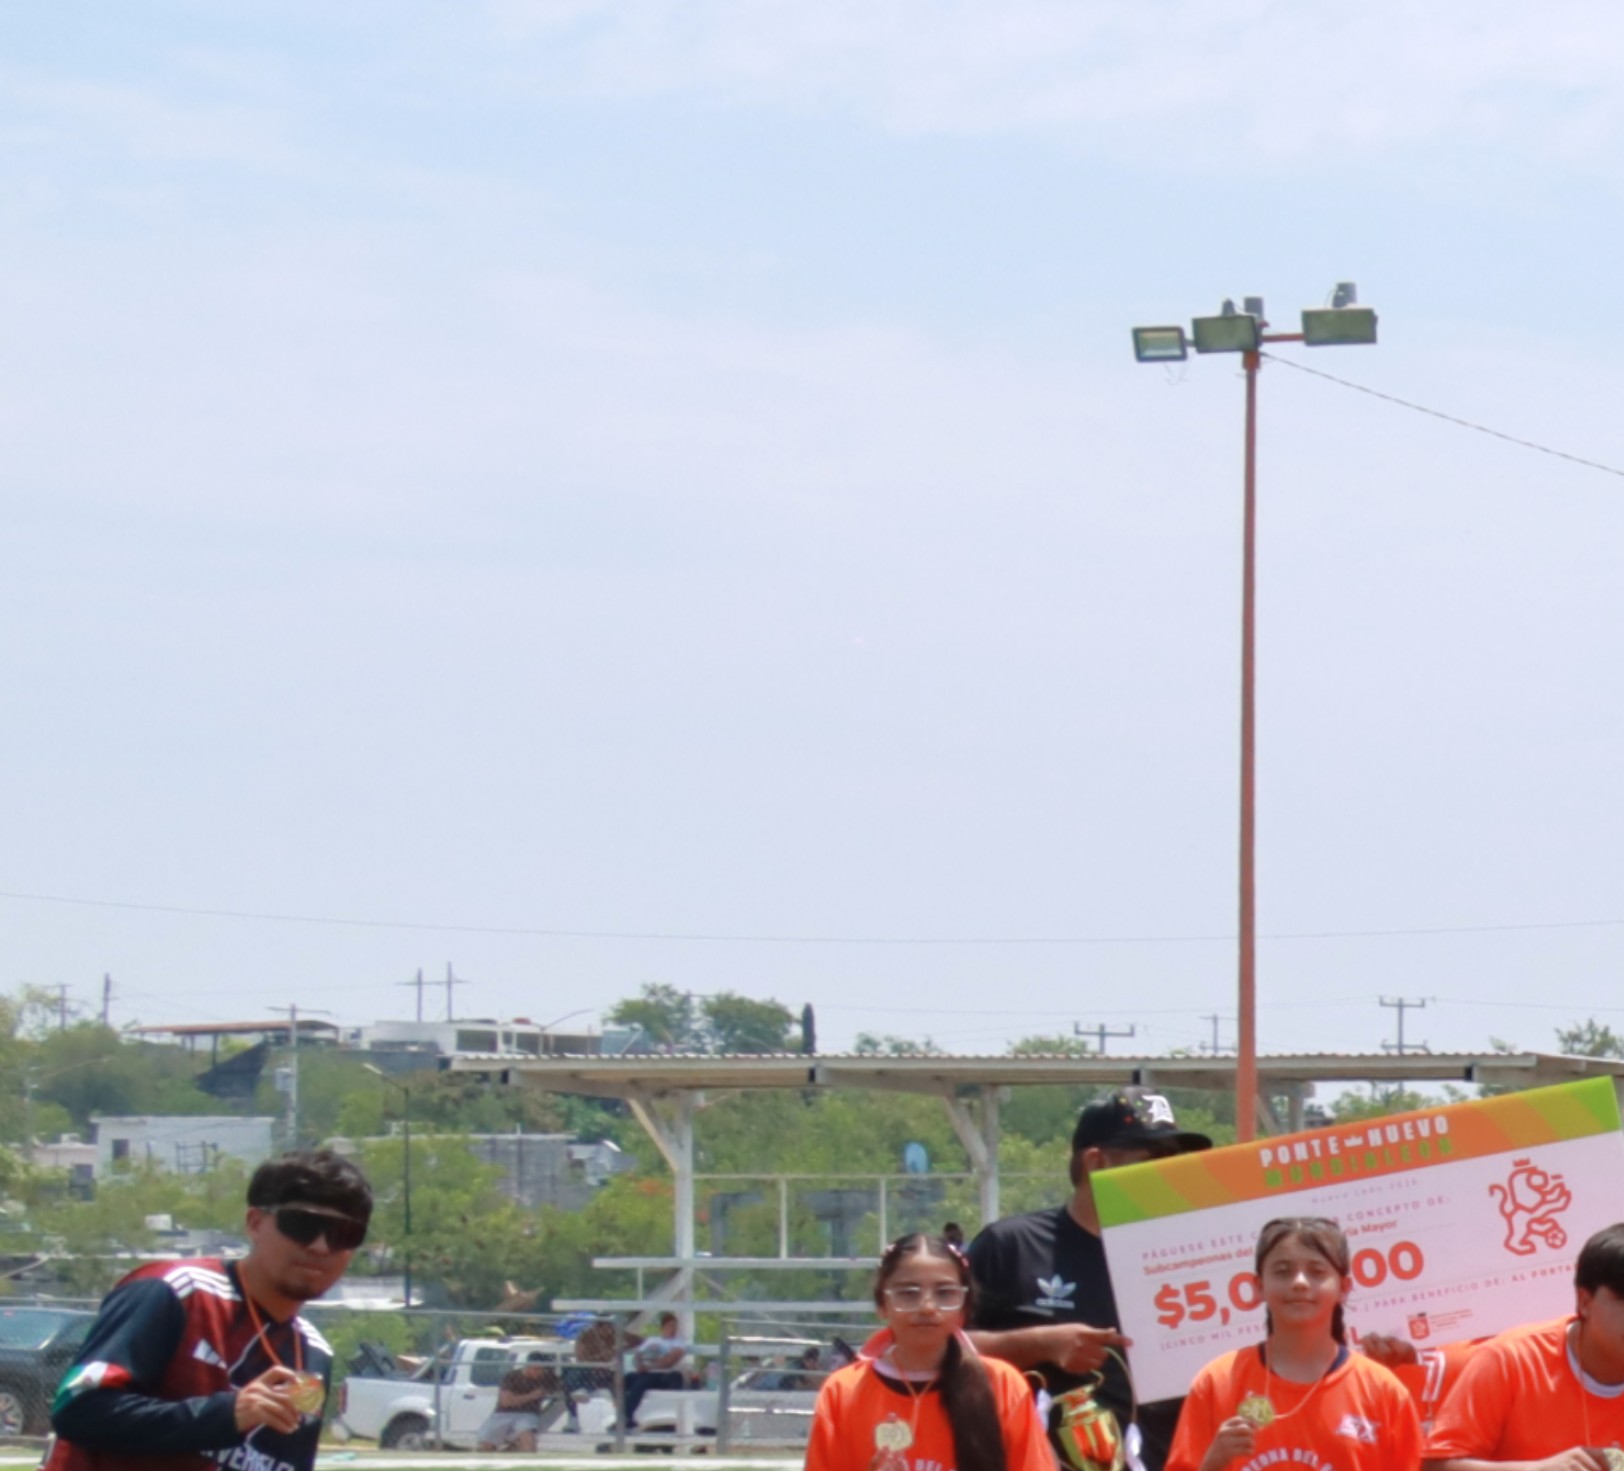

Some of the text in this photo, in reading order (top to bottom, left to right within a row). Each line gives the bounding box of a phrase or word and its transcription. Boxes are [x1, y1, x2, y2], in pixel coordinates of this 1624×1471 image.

[1259, 1114, 1449, 1168] PONTE NUEVO
[1293, 1448, 1320, 1468] DEL
